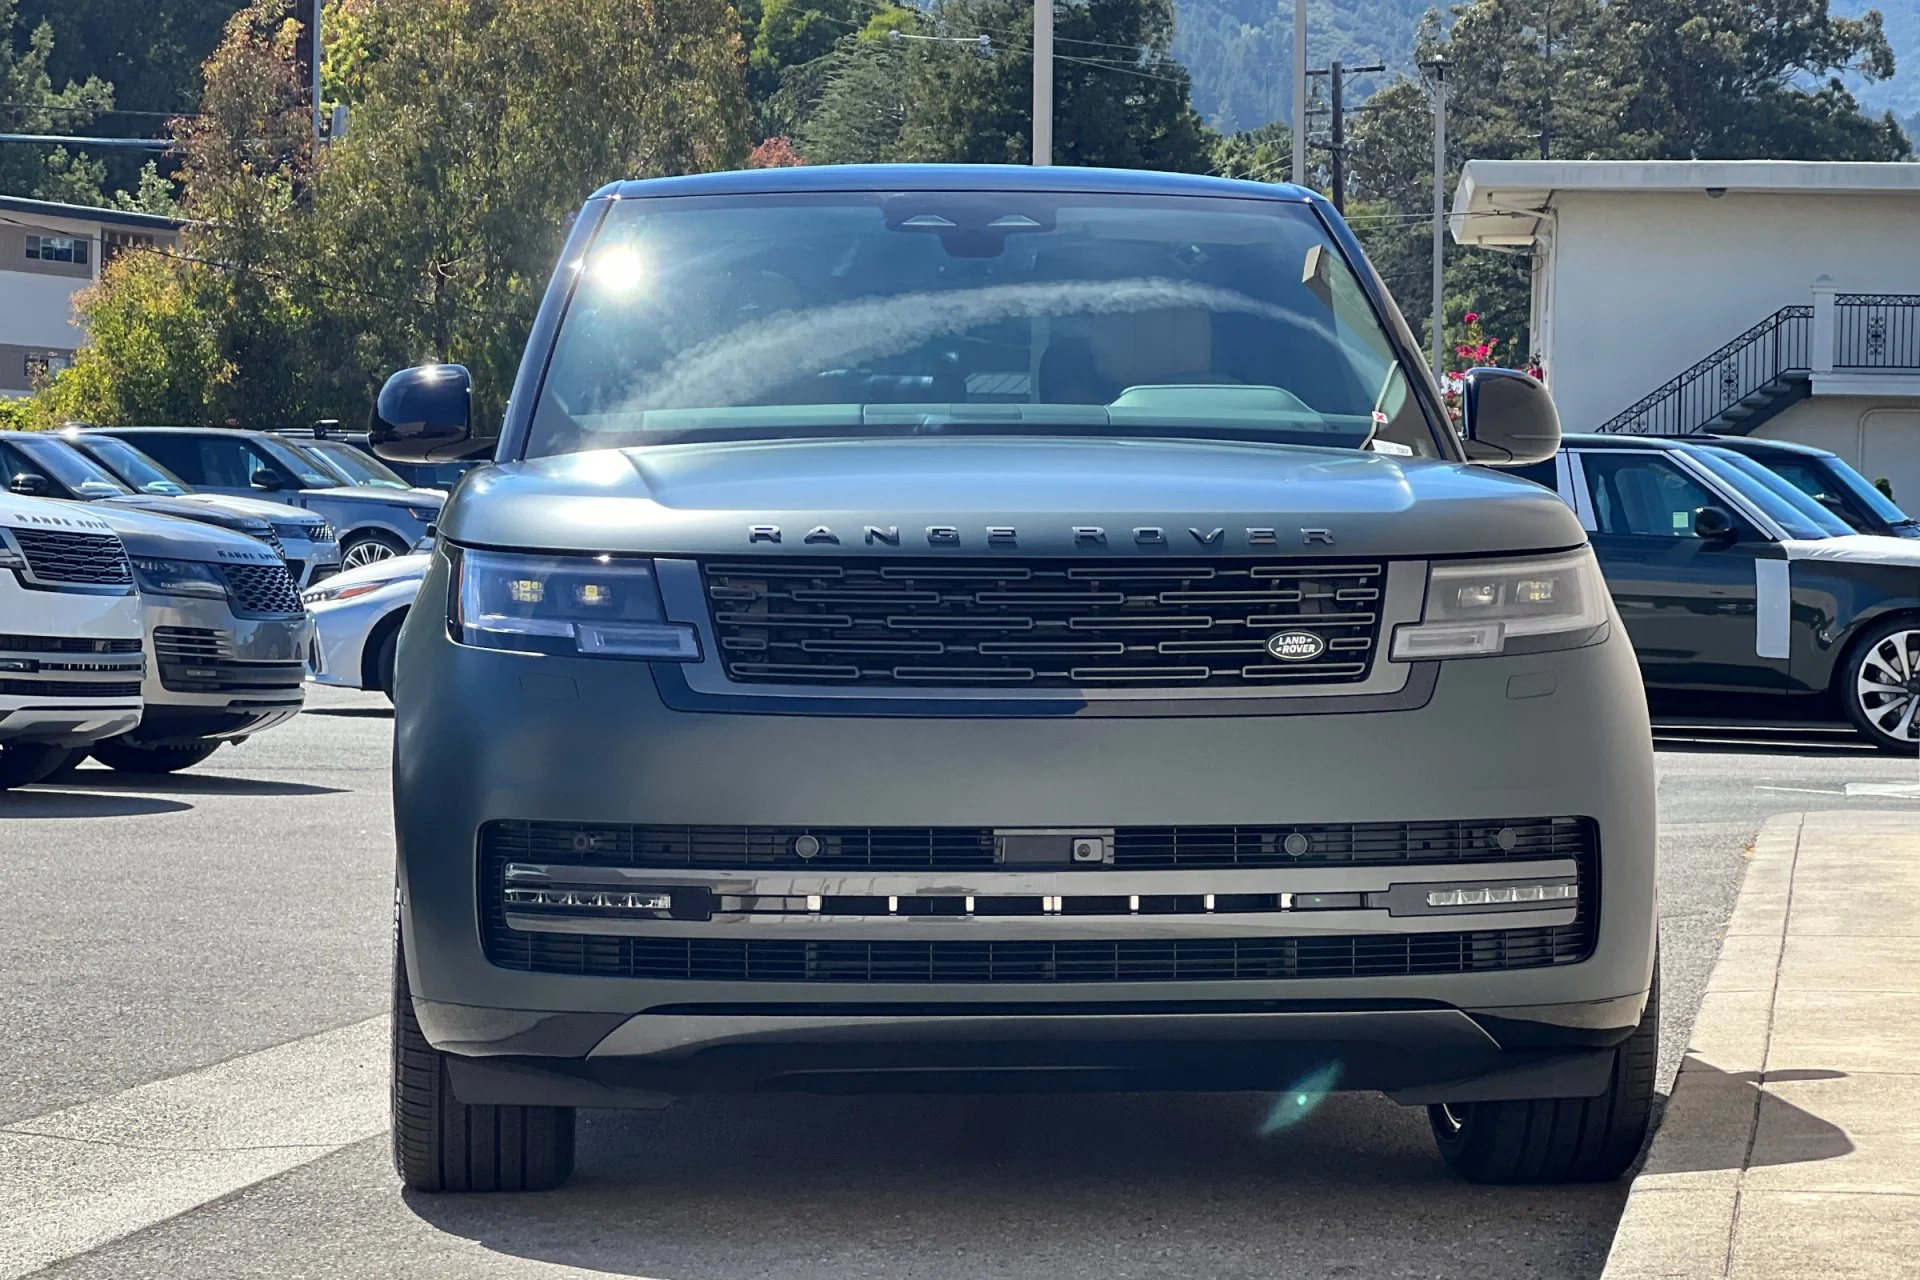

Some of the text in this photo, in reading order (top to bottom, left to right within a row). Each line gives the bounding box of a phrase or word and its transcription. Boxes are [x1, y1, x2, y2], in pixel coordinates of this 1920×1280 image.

[748, 525, 1335, 545] RANGE ROVER
[1278, 636, 1306, 645] LAND
[1282, 644, 1316, 654] ROVER
